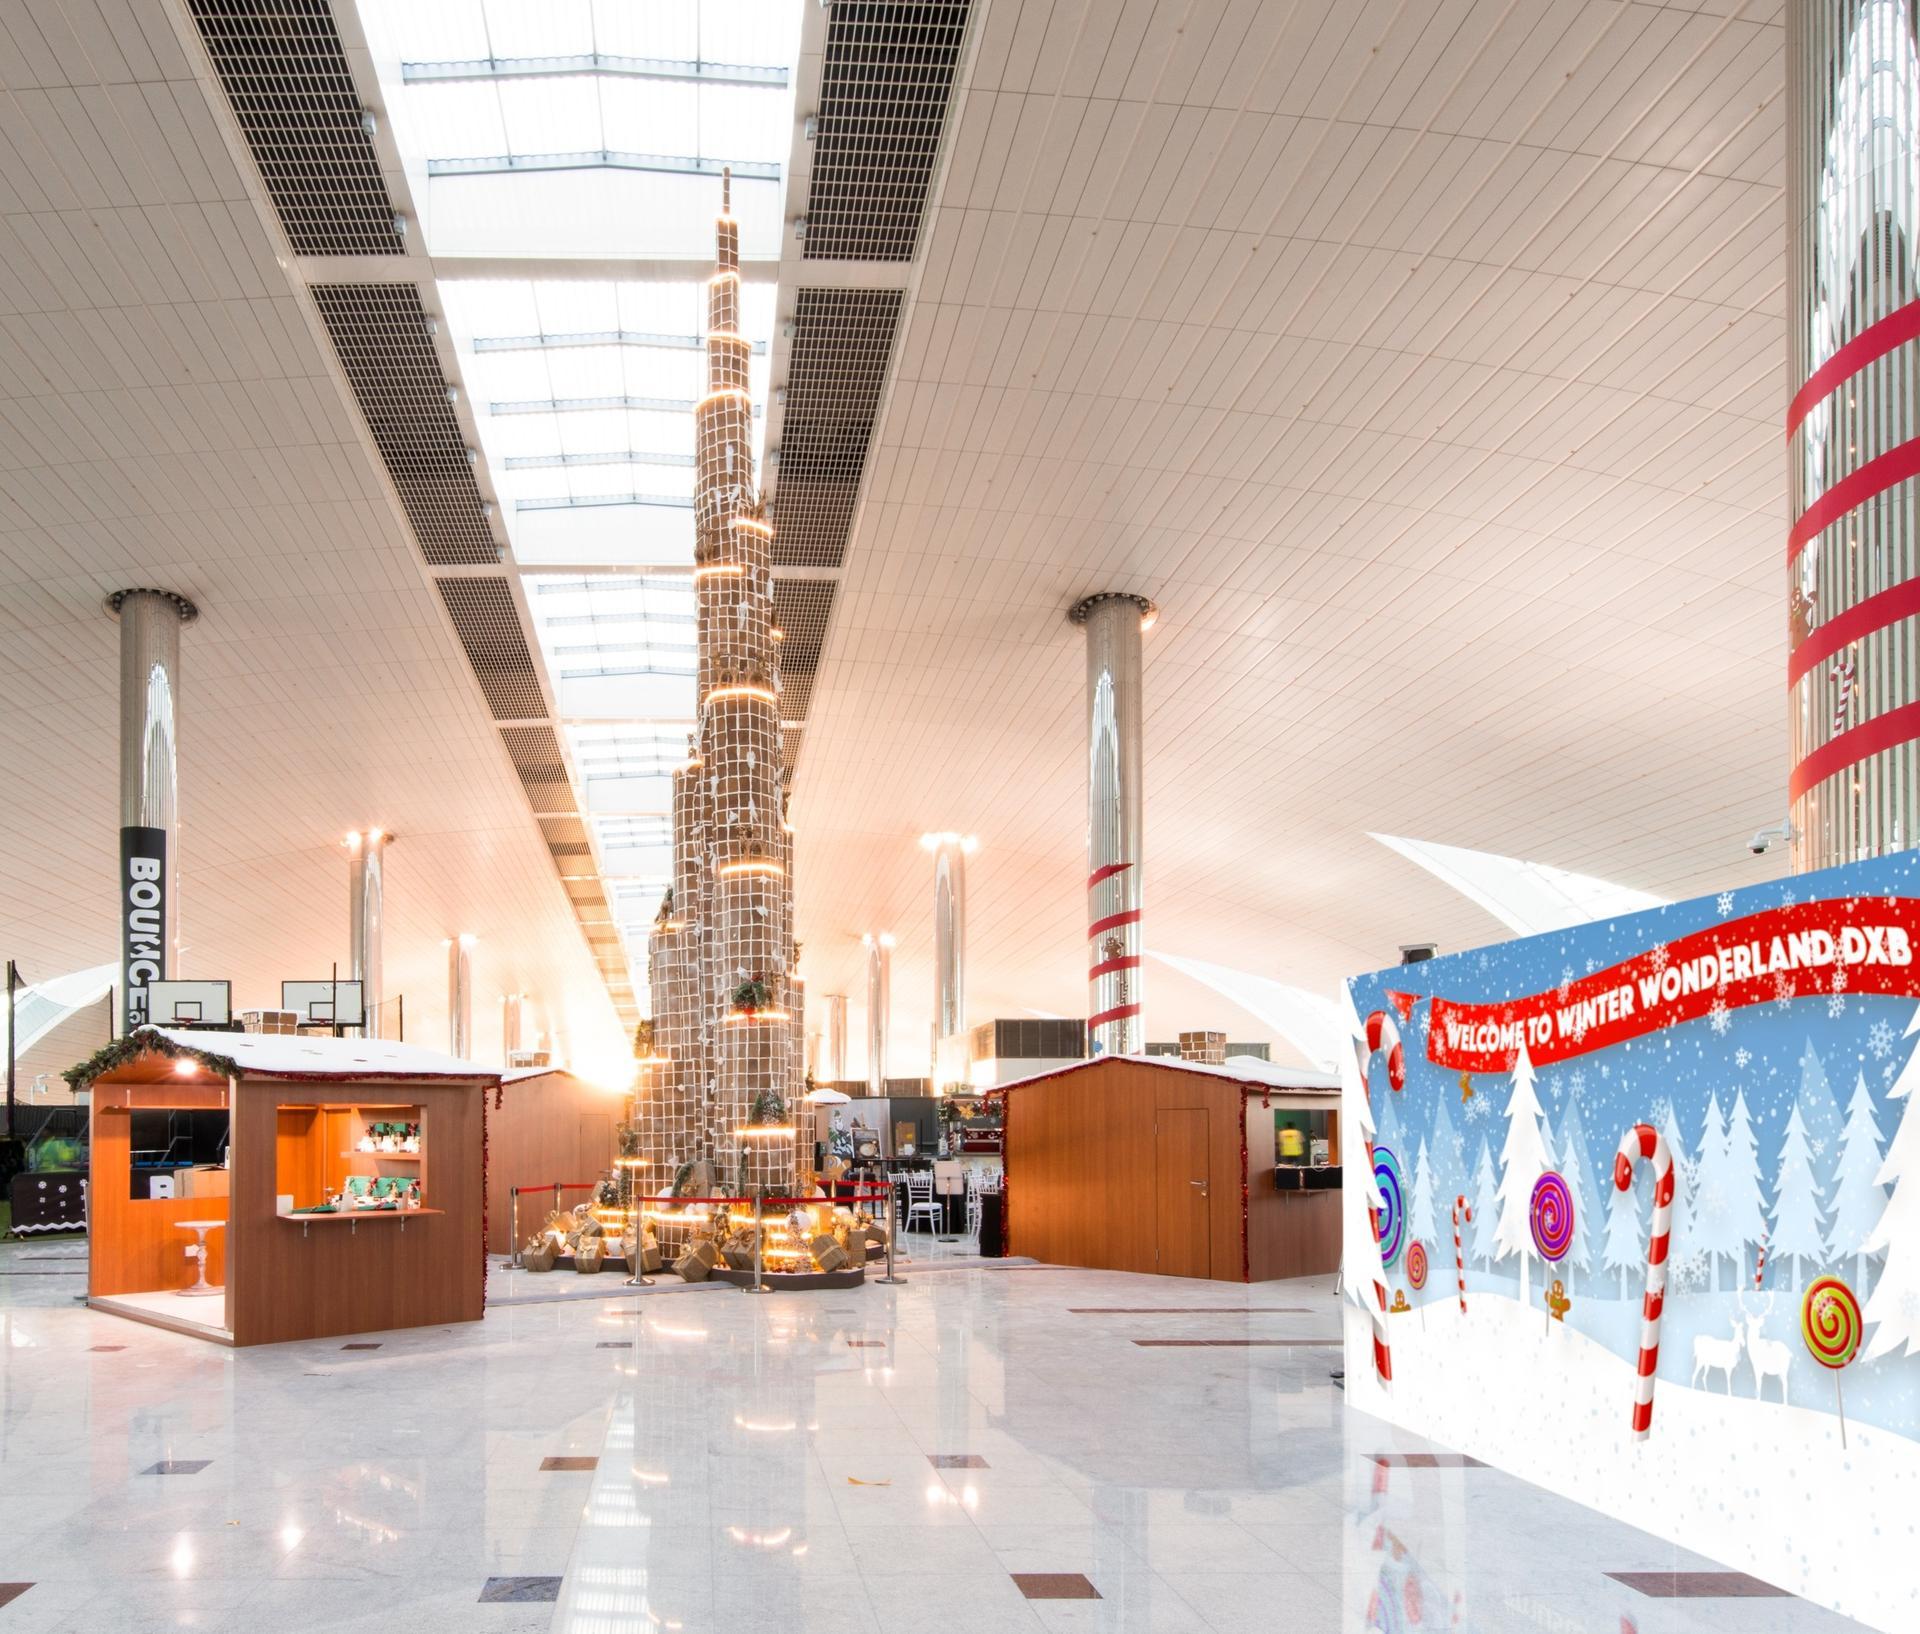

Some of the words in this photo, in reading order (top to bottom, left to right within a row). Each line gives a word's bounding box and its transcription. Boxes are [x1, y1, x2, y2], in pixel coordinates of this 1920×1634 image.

[129, 857, 161, 1009] BOUNCE
[1446, 1020, 1527, 1053] WELCOME
[1527, 1012, 1553, 1047] TO
[1556, 985, 1635, 1039] WINTER
[1638, 929, 1835, 1010] WONDERLAND
[1841, 926, 1913, 966] DXB
